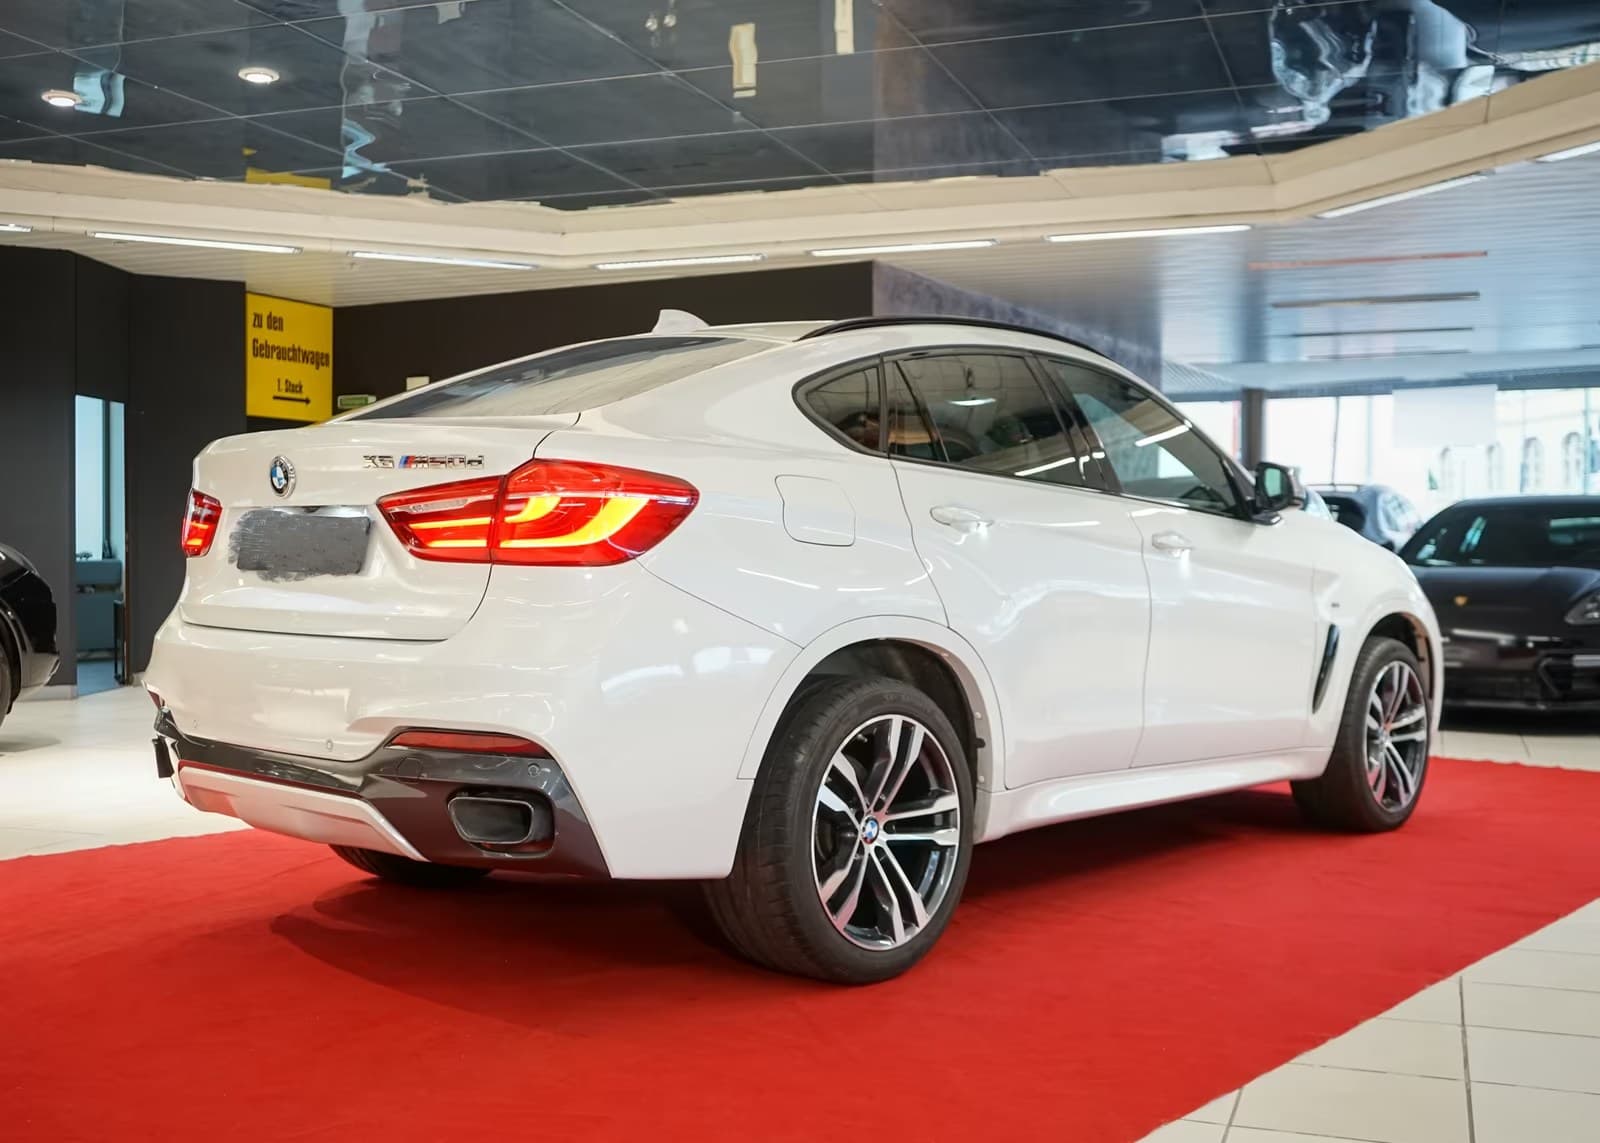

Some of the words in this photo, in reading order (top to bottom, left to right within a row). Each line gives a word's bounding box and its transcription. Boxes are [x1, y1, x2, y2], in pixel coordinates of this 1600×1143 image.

[252, 312, 263, 328] zu
[266, 311, 284, 332] den
[252, 338, 330, 370] Gebrauchtwagen
